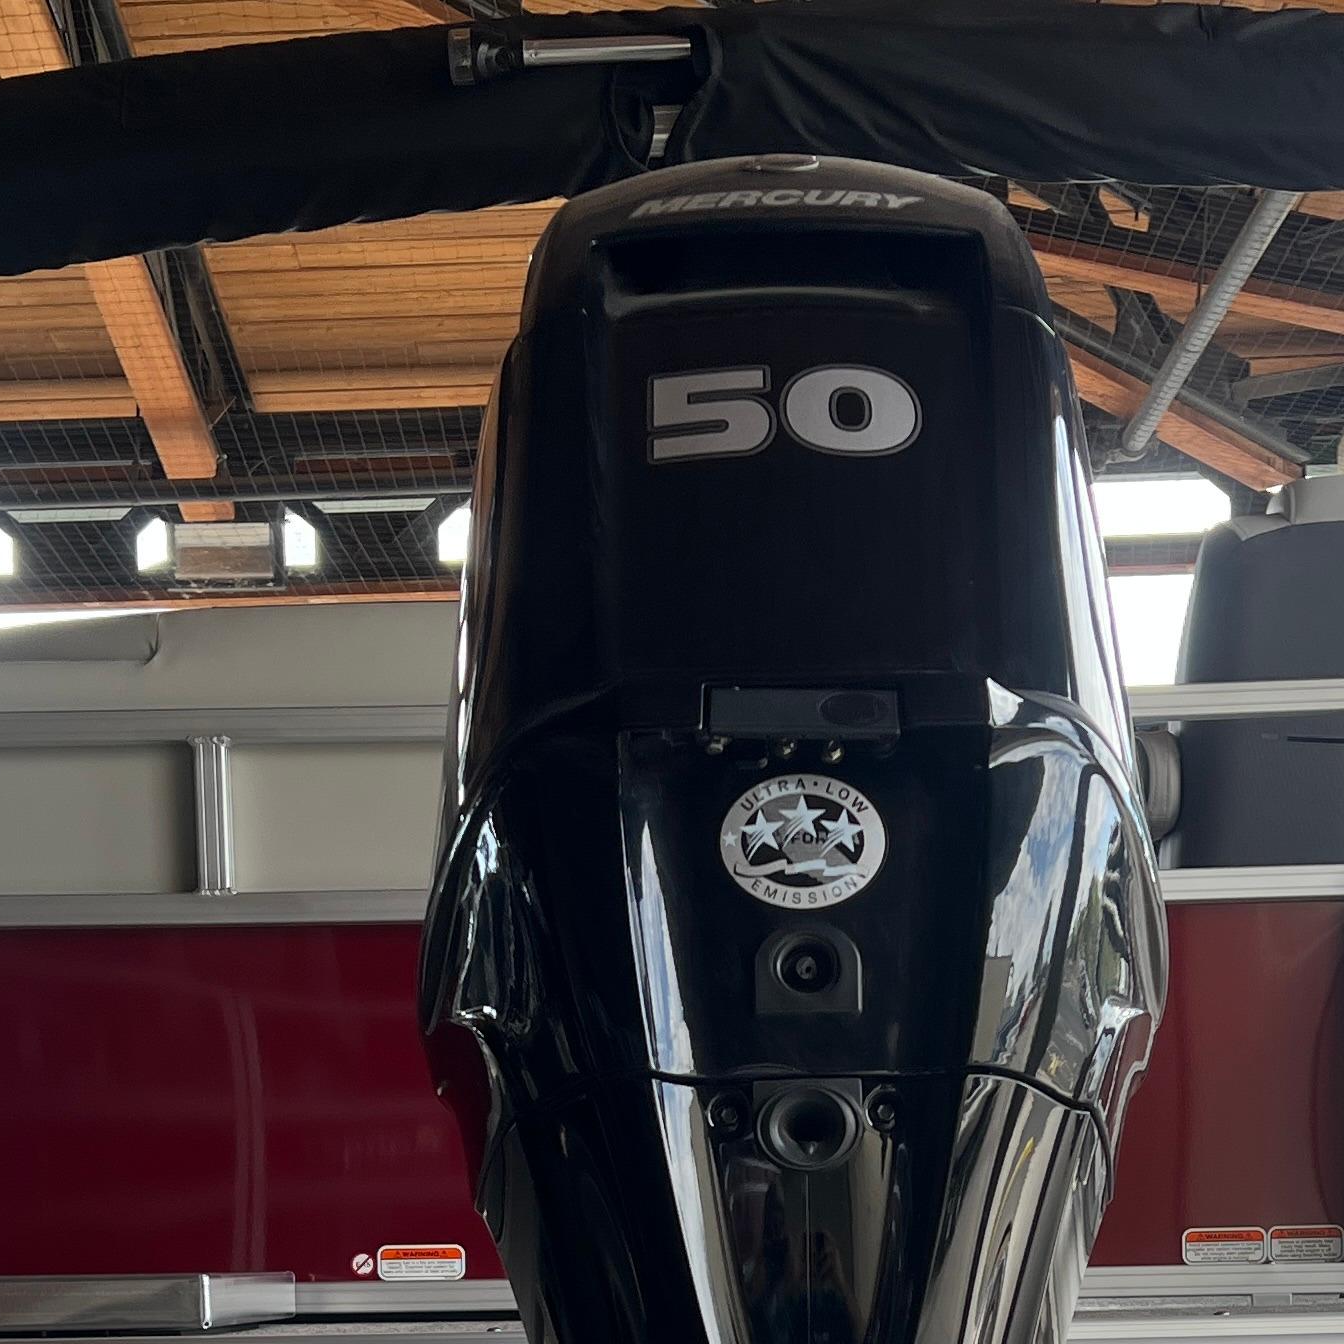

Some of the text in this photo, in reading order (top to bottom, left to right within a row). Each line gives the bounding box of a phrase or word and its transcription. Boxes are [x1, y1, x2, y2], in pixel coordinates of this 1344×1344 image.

[629, 189, 925, 220] MERCURY
[648, 364, 922, 464] 50
[740, 777, 869, 814] ULTRA LOW
